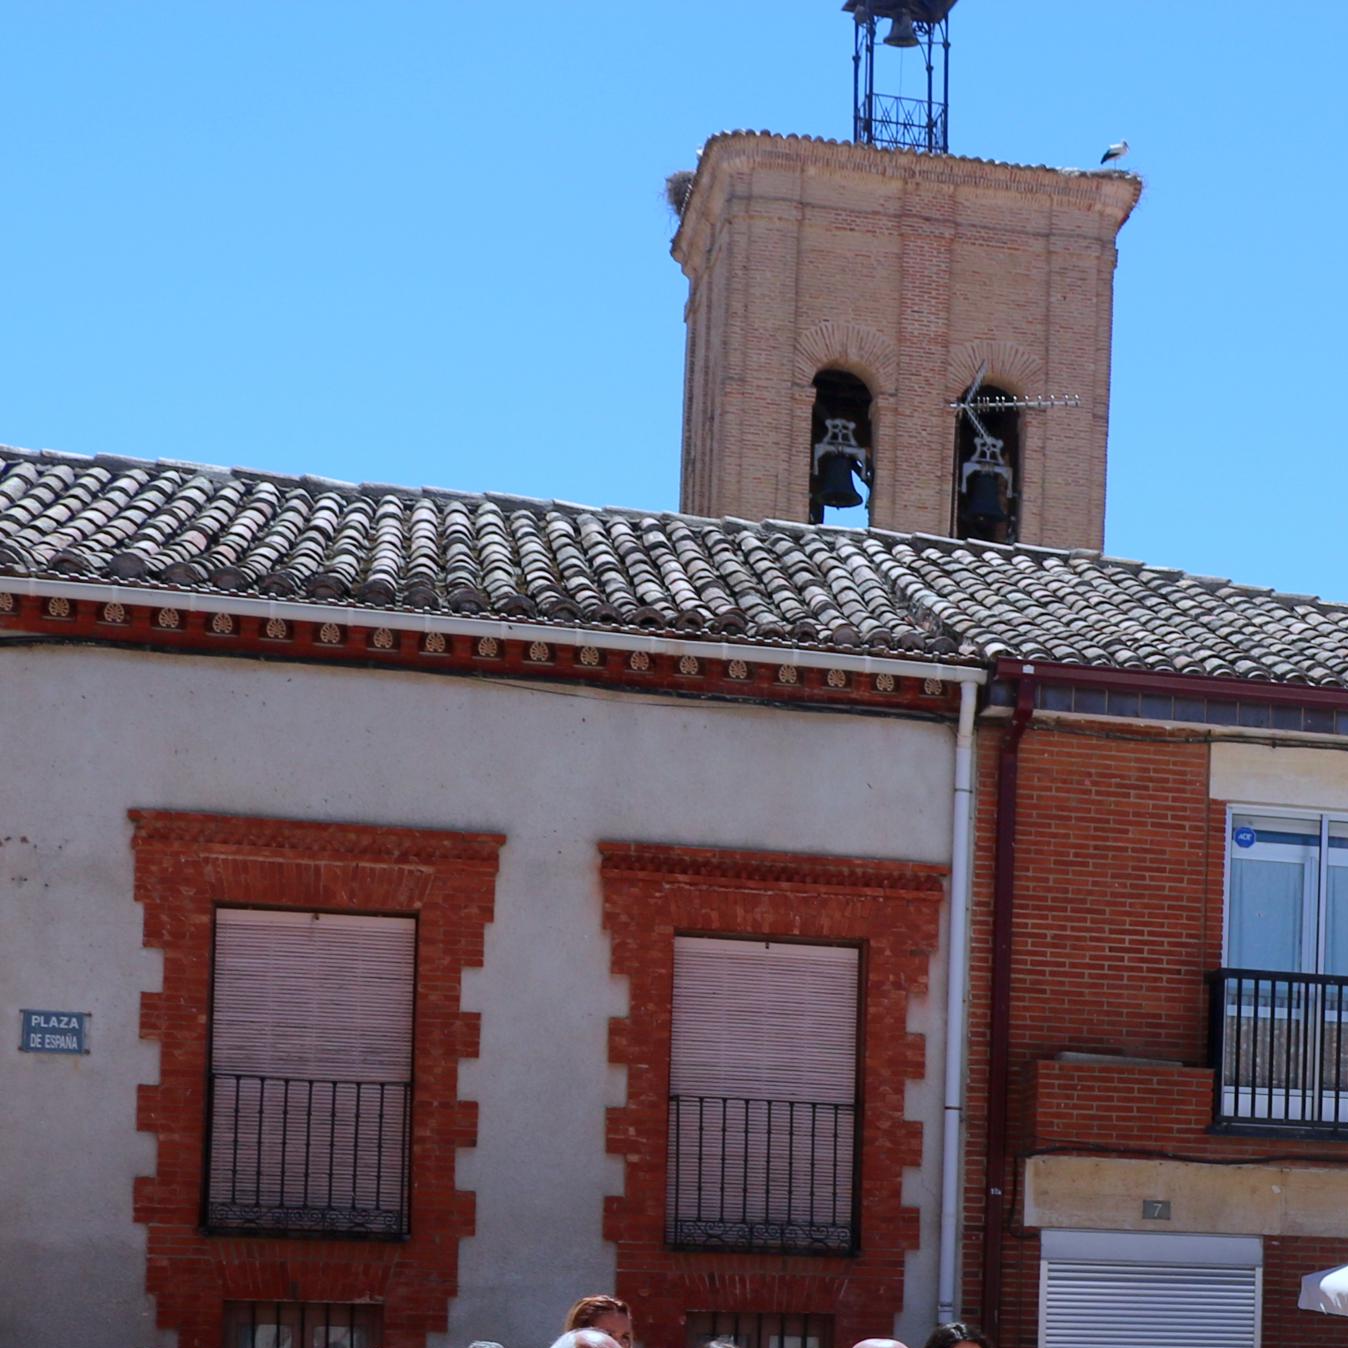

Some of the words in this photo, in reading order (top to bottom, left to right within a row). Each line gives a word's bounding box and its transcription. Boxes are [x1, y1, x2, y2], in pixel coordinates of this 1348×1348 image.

[31, 1015, 79, 1029] PLAZA
[30, 1033, 43, 1048] DE
[45, 1032, 78, 1050] ESPAÑA
[1153, 1203, 1162, 1217] 7
